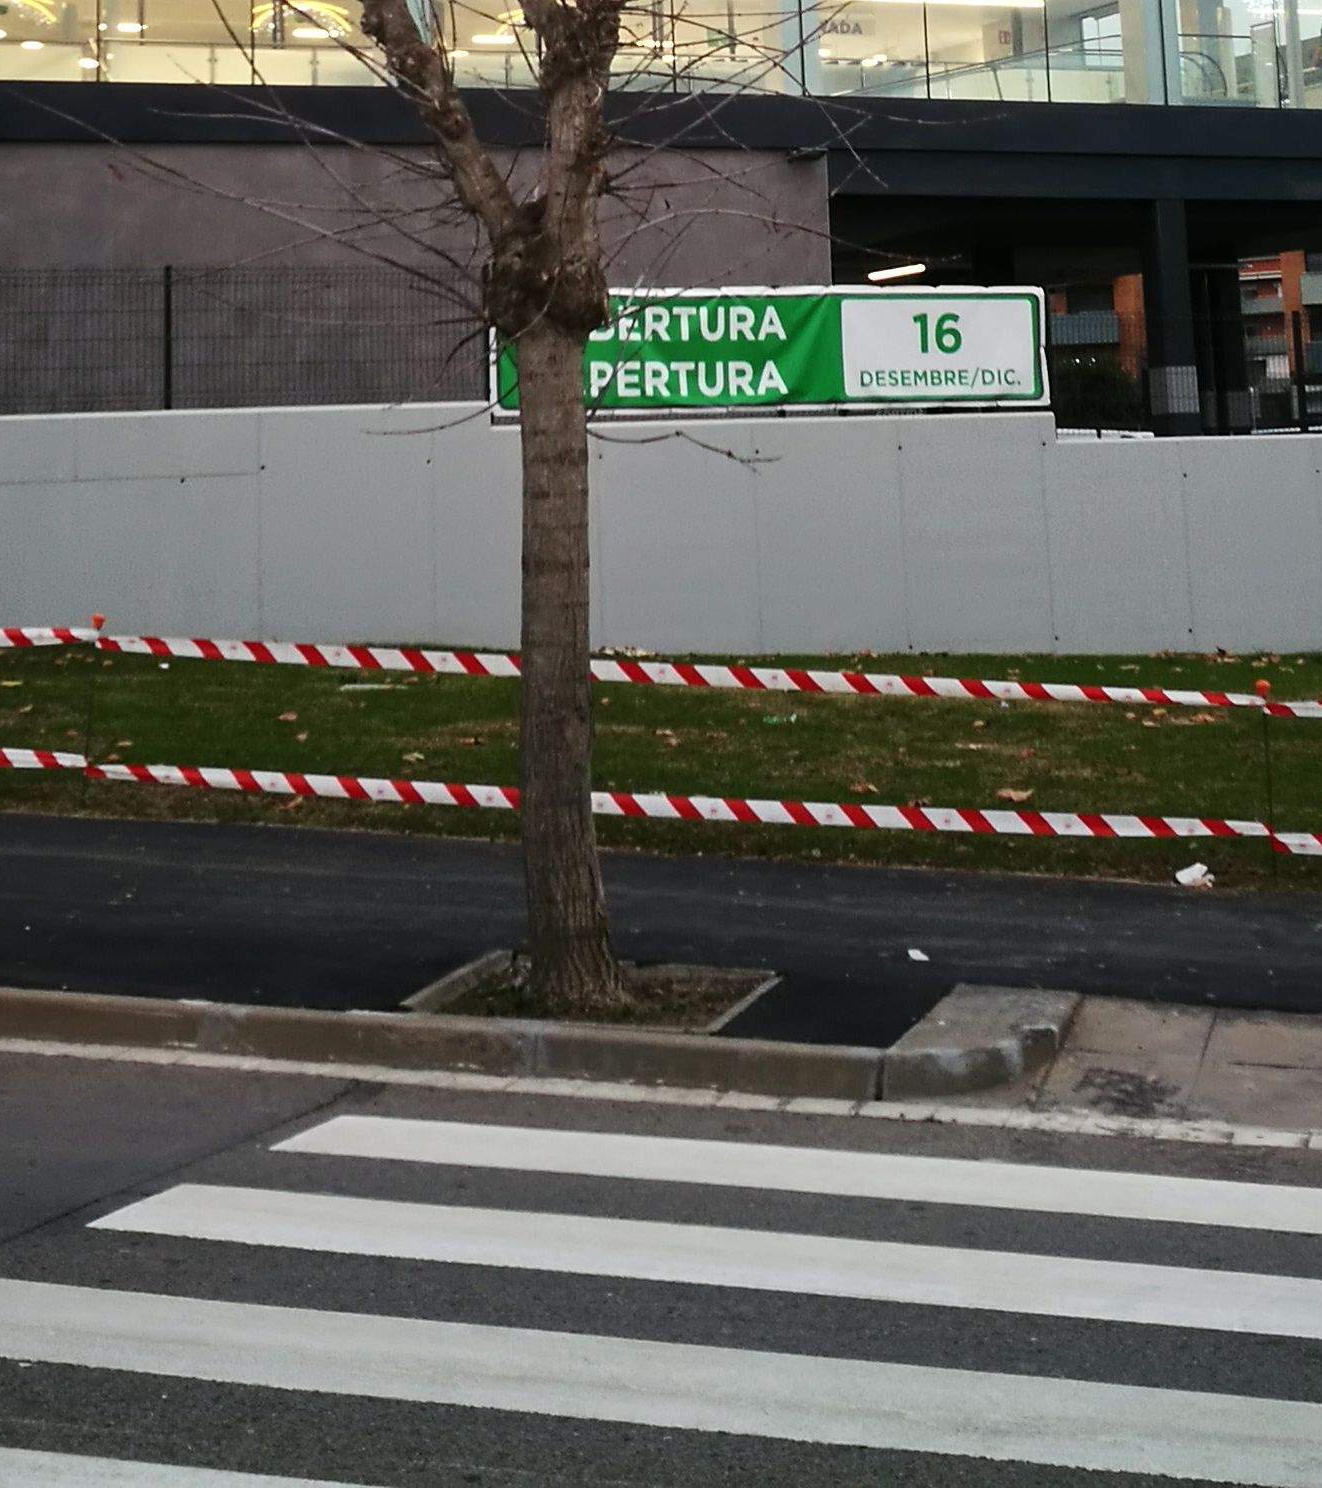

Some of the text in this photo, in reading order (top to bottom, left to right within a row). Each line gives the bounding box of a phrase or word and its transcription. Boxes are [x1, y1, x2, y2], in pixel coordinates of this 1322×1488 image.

[588, 305, 787, 342] ERTURA
[913, 312, 963, 354] 16
[586, 360, 789, 398] PERTURA
[859, 367, 1022, 388] DESEMBRE/DIC.
